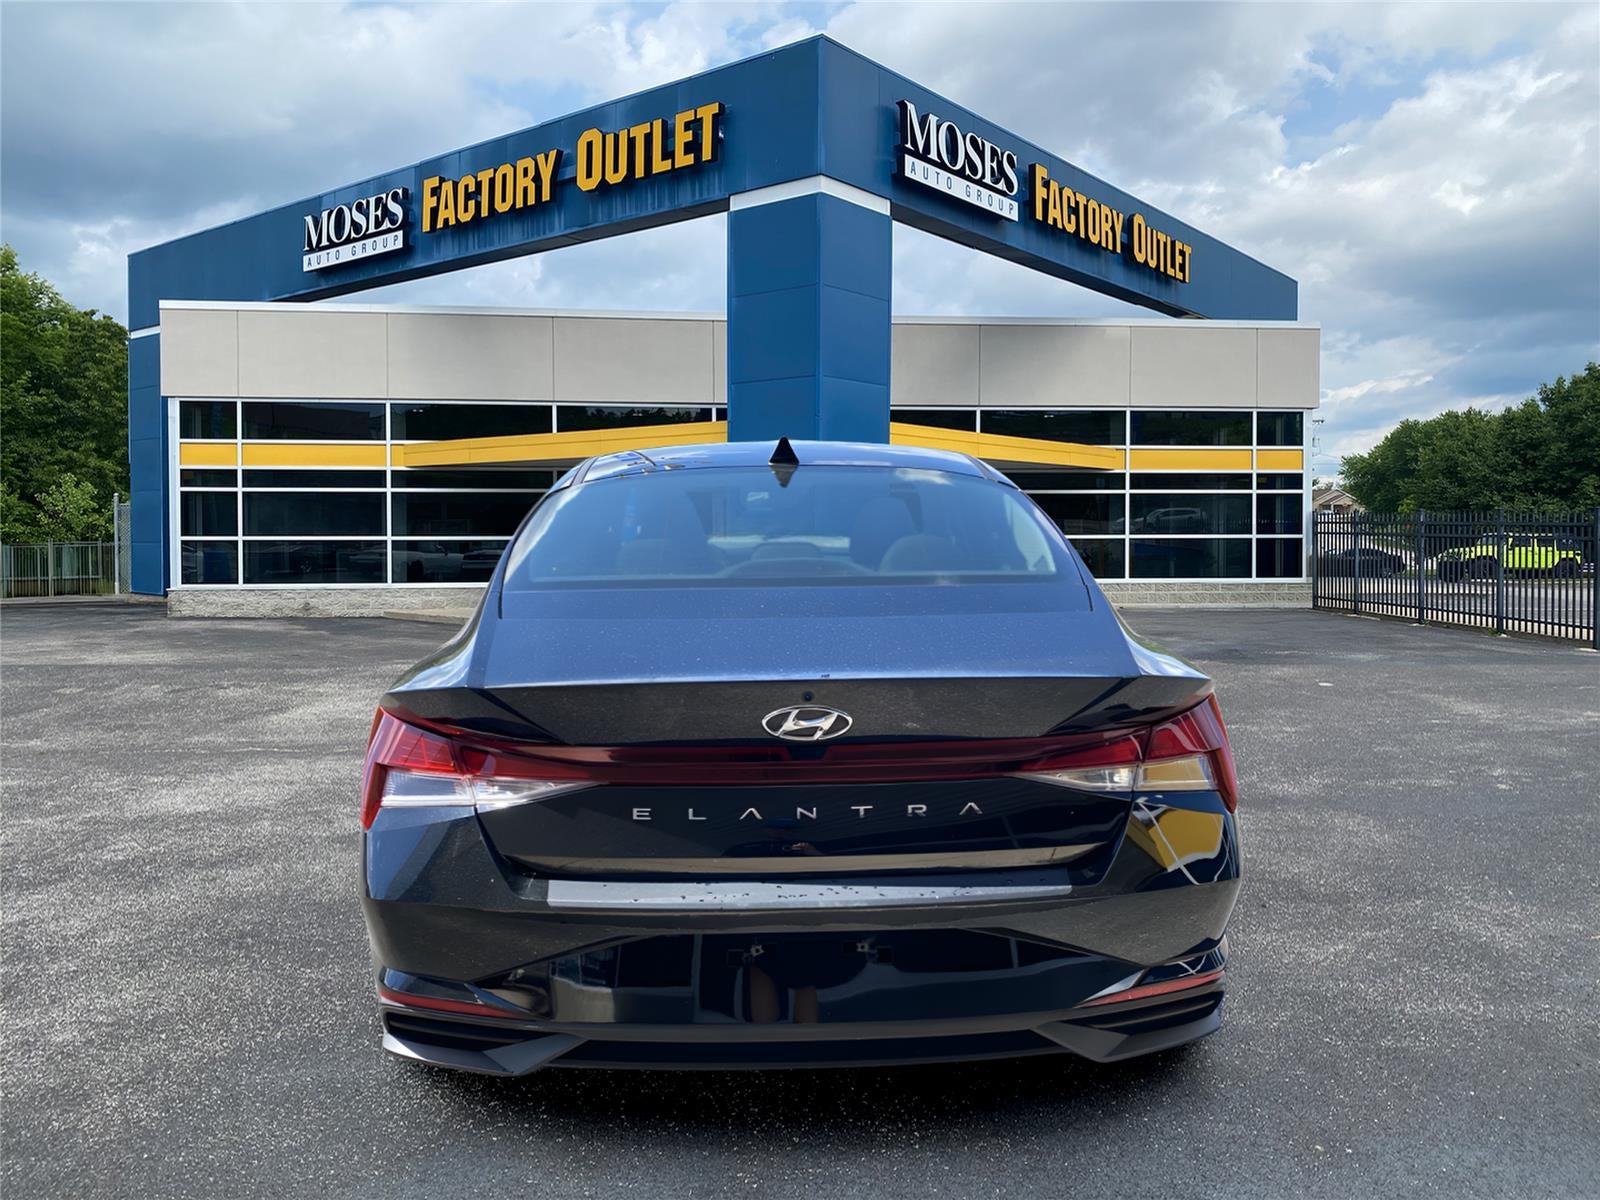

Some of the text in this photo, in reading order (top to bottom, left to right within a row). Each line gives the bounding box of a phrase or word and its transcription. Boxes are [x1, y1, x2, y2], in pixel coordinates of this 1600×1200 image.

[422, 102, 720, 232] FACTORY OUTLET
[904, 100, 1018, 195] MOSES
[910, 161, 1014, 214] AUTO GROUP
[303, 188, 403, 251] MOSES
[307, 234, 399, 268] AUTO GROUP
[1034, 163, 1192, 283] FACTORY OUTLET
[632, 802, 983, 821] ELANTRA
